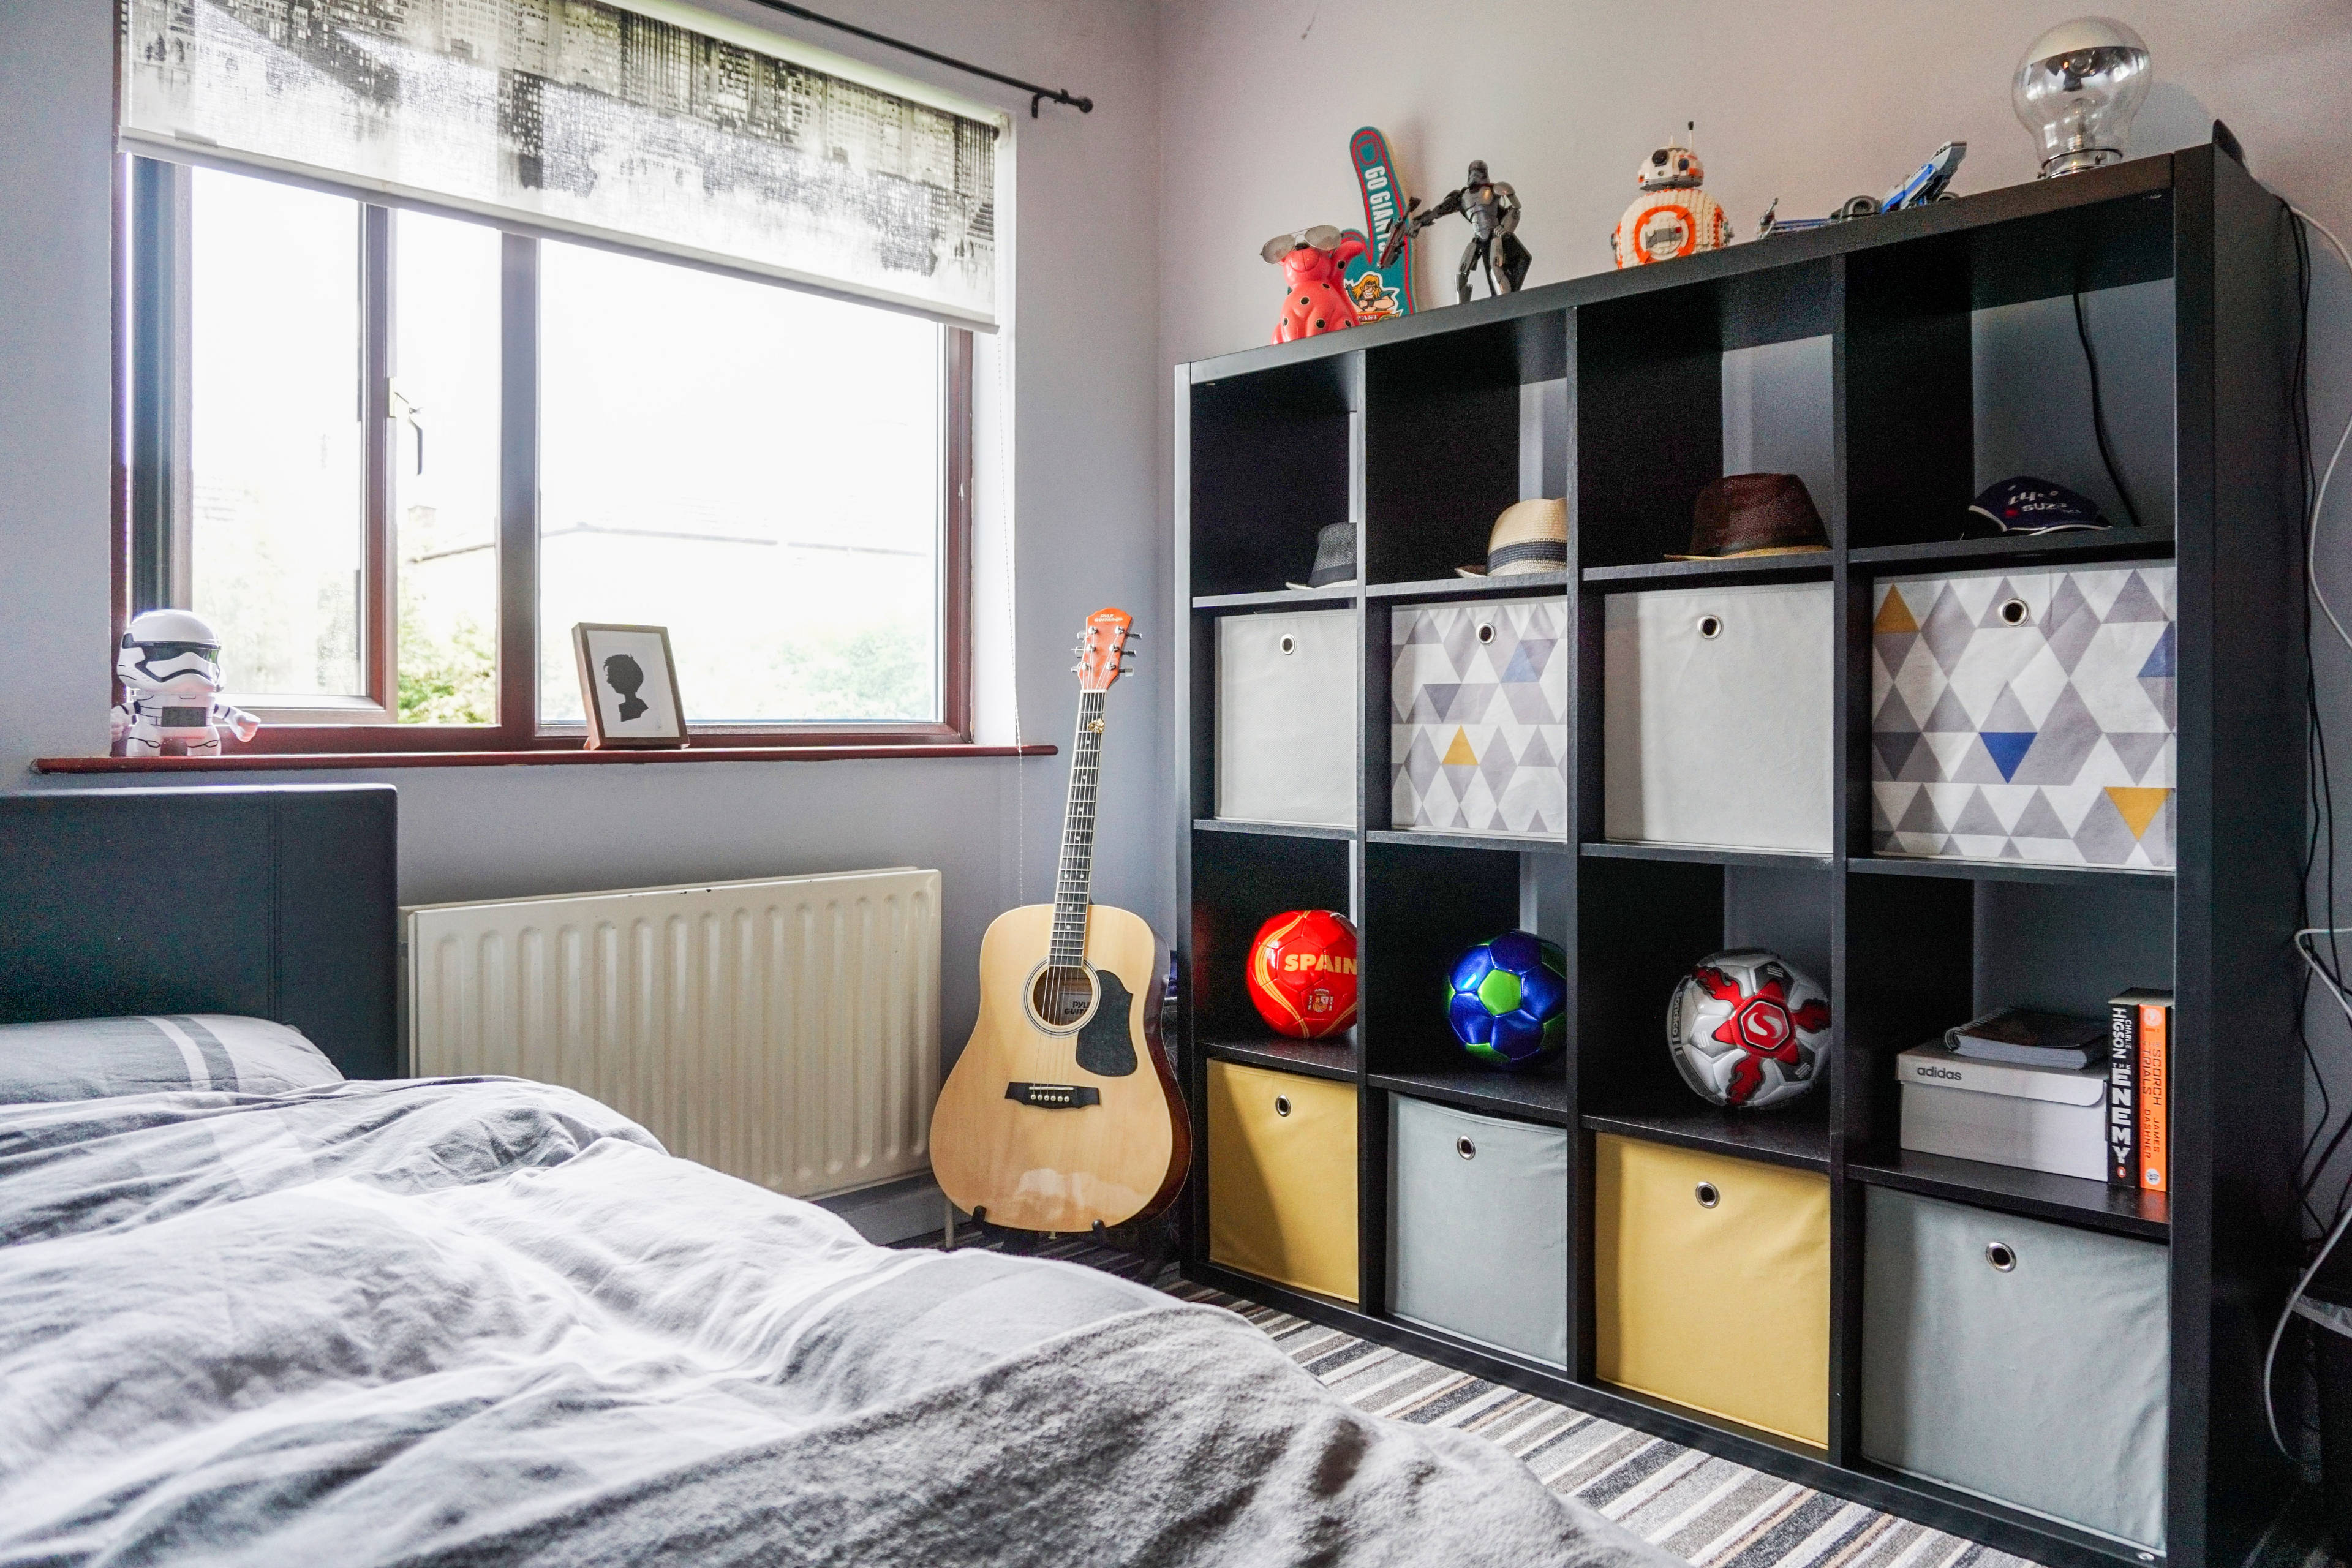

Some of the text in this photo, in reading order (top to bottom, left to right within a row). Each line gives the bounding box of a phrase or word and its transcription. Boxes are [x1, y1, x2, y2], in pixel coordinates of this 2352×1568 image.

[1365, 165, 1393, 257] GO GIANT
[1284, 954, 1357, 976] SPAIN
[2112, 1008, 2127, 1058] HIGSON
[1917, 1066, 1962, 1080] adidas
[2142, 1050, 2152, 1095] TRIALS
[2152, 1049, 2162, 1106] SCORCH
[2112, 1068, 2131, 1163] ENEMY
